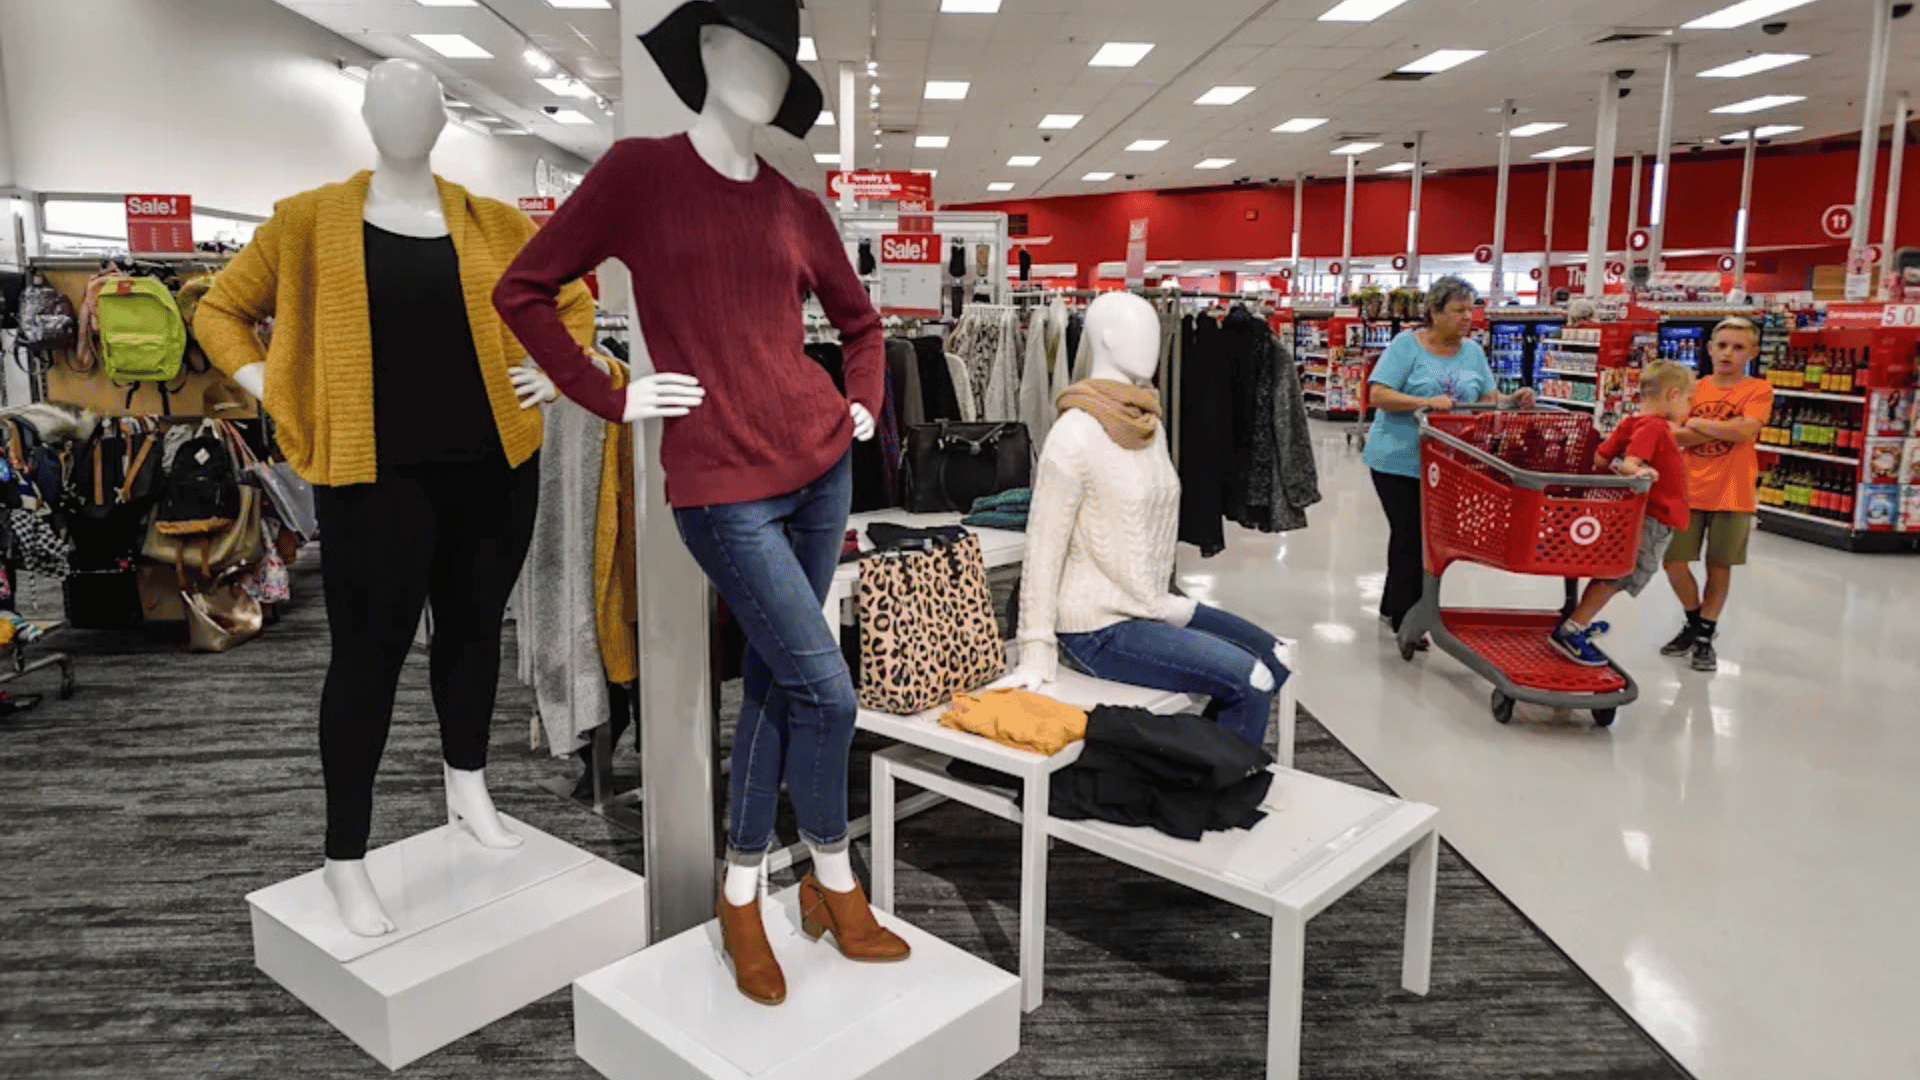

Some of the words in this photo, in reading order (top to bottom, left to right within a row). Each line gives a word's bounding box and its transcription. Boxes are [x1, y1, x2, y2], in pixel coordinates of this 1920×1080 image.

[127, 196, 177, 215] Sale!
[899, 200, 927, 211] Sale!
[1832, 213, 1848, 230] 11
[1634, 234, 1644, 247] 9
[883, 237, 928, 260] Sale!
[1479, 249, 1487, 261] 7
